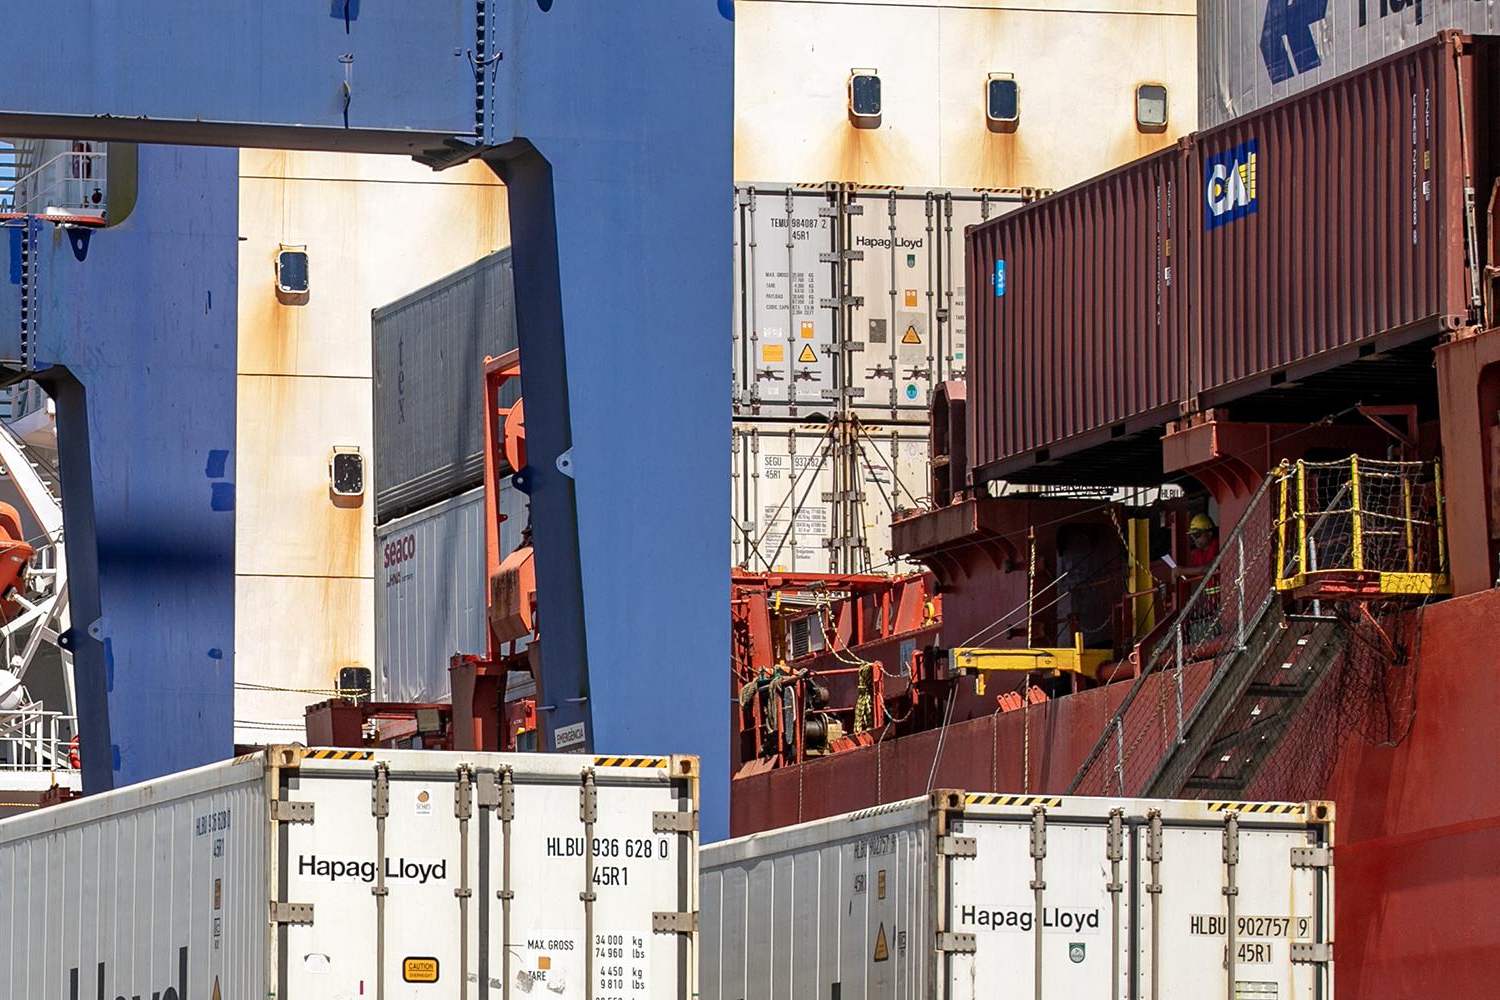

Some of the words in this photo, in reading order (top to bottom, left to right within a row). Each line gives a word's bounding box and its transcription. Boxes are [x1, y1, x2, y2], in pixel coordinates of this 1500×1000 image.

[771, 218, 789, 227] TEMU
[792, 218, 818, 228] 984087
[821, 219, 827, 229] 2
[792, 230, 810, 240] 45R1
[856, 236, 923, 250] HapagLloyd
[764, 457, 782, 466] SEGU
[765, 470, 781, 479] 45R1
[384, 534, 415, 568] seaco
[547, 837, 584, 857] HLBU
[592, 838, 619, 857] 936
[625, 839, 652, 858] 628
[660, 839, 668, 858] 0
[592, 866, 628, 886] 45R1
[1191, 916, 1226, 934] HLBU
[1237, 917, 1290, 936] 902757
[1299, 919, 1308, 937] 9
[527, 939, 546, 950] MAX.
[548, 940, 574, 951] GROSS
[632, 936, 643, 948] kg
[632, 949, 645, 958] lbs
[1238, 944, 1271, 962] 45R1
[528, 971, 546, 981] TARE
[632, 967, 643, 979] kg
[632, 980, 645, 989] lbs
